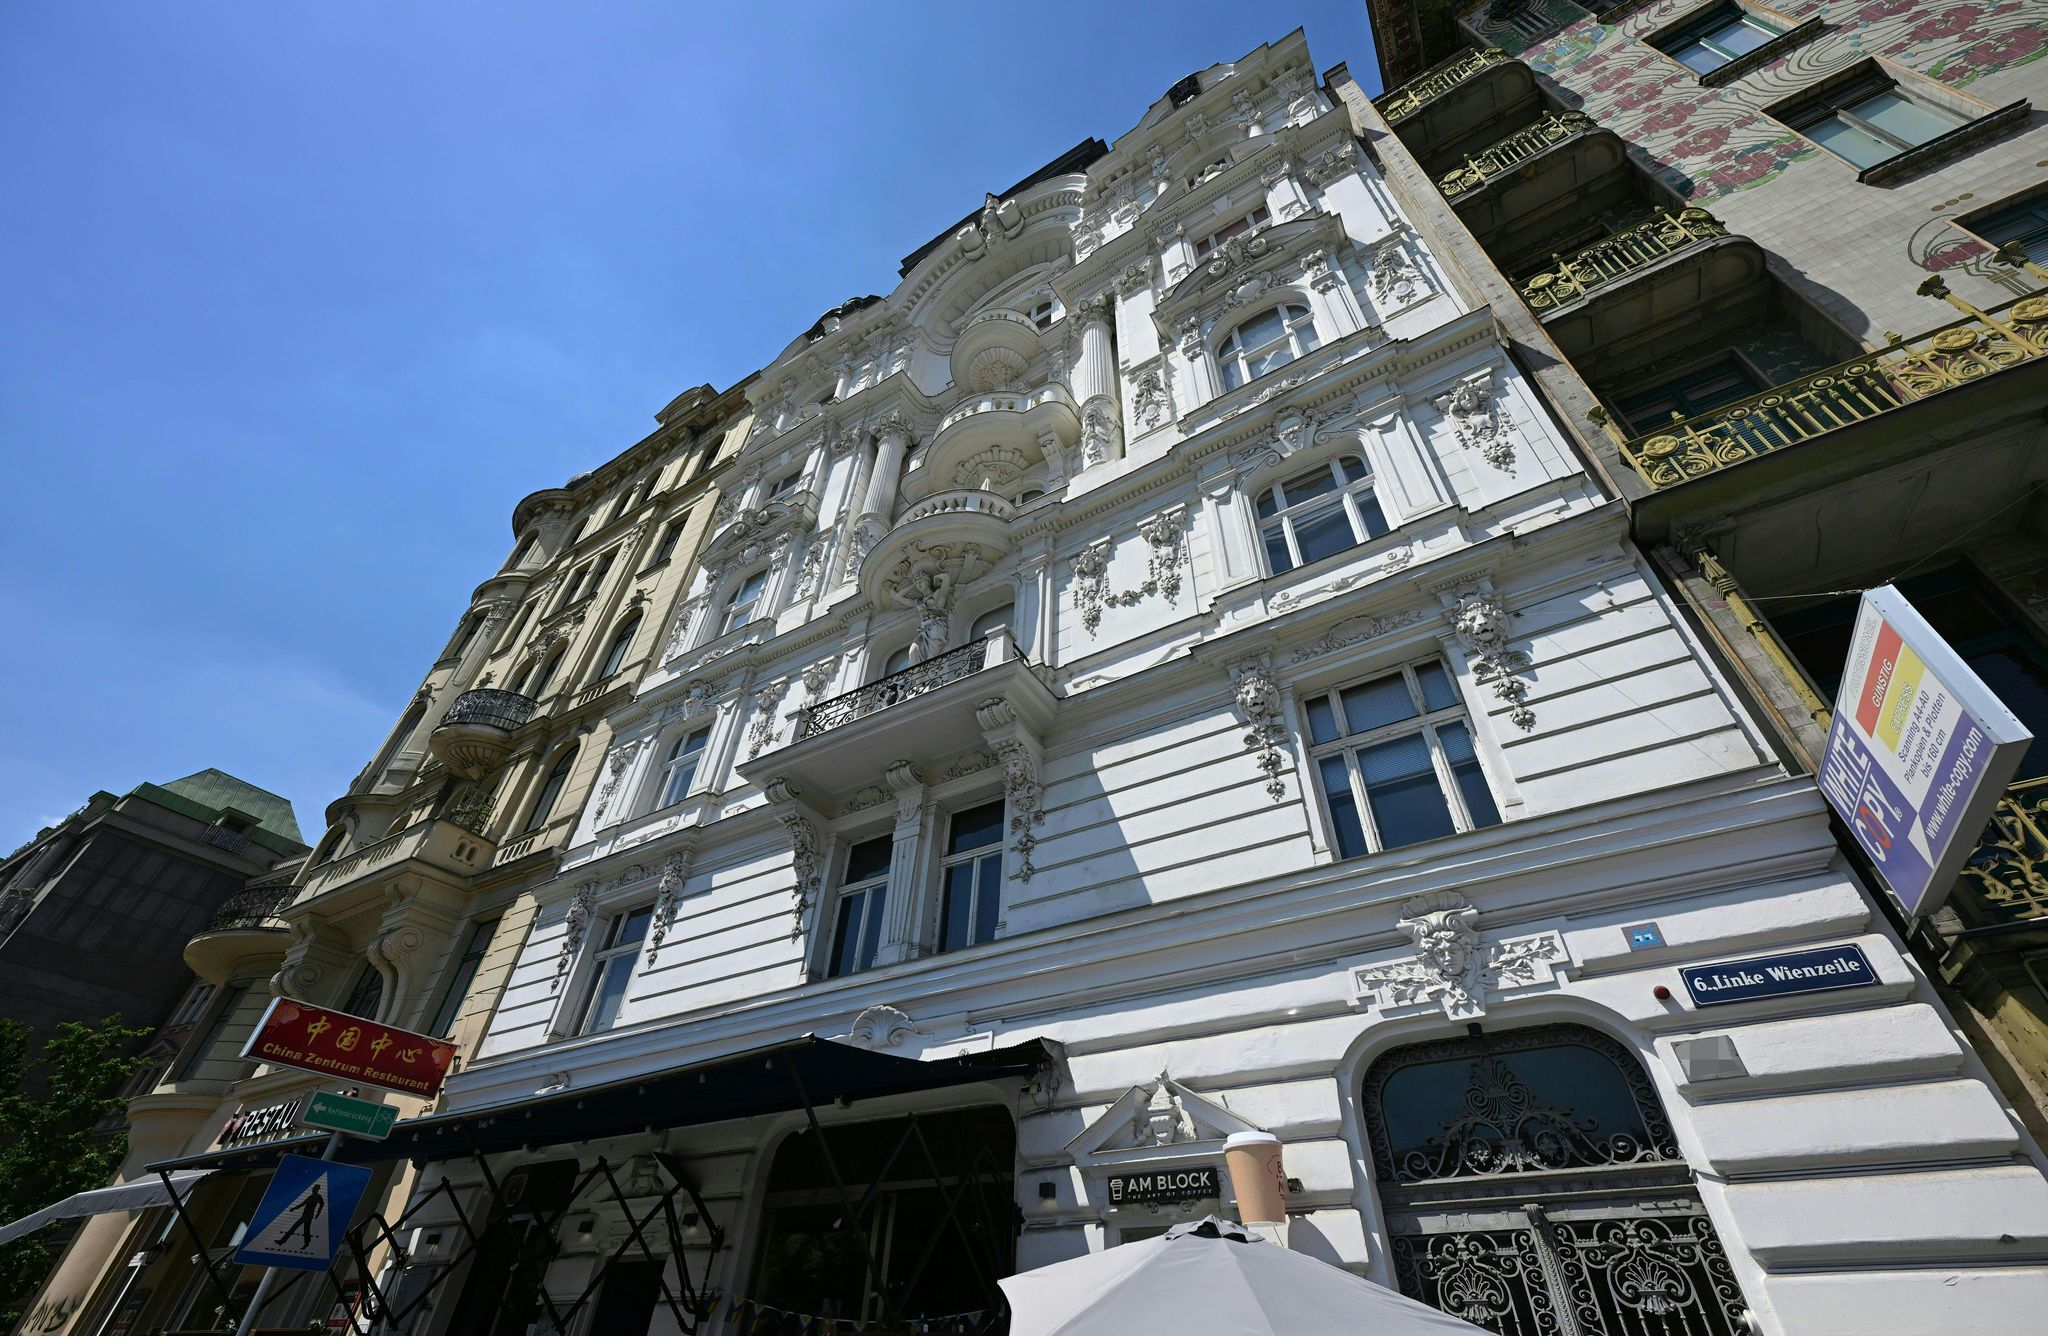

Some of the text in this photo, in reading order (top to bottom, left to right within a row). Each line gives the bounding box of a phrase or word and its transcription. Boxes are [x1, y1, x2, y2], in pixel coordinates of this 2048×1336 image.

[1872, 658, 1893, 708] GÜNSTIG
[1890, 681, 1914, 735] EXPRESS
[1898, 690, 1930, 763] Scanning A4-A0
[1904, 692, 1946, 785] Plankopien & Plotten
[1823, 721, 1869, 817] WHITE
[1922, 729, 1947, 778] bis 160 cm
[1925, 726, 1984, 840] www.white-copy.com
[1855, 773, 1901, 863] COPY
[1765, 957, 1861, 982] Wienzeile
[262, 1042, 430, 1091] China Zentrum Restaurant
[236, 1098, 303, 1139] RESTAU
[1127, 1171, 1211, 1193] AM BLOCK
